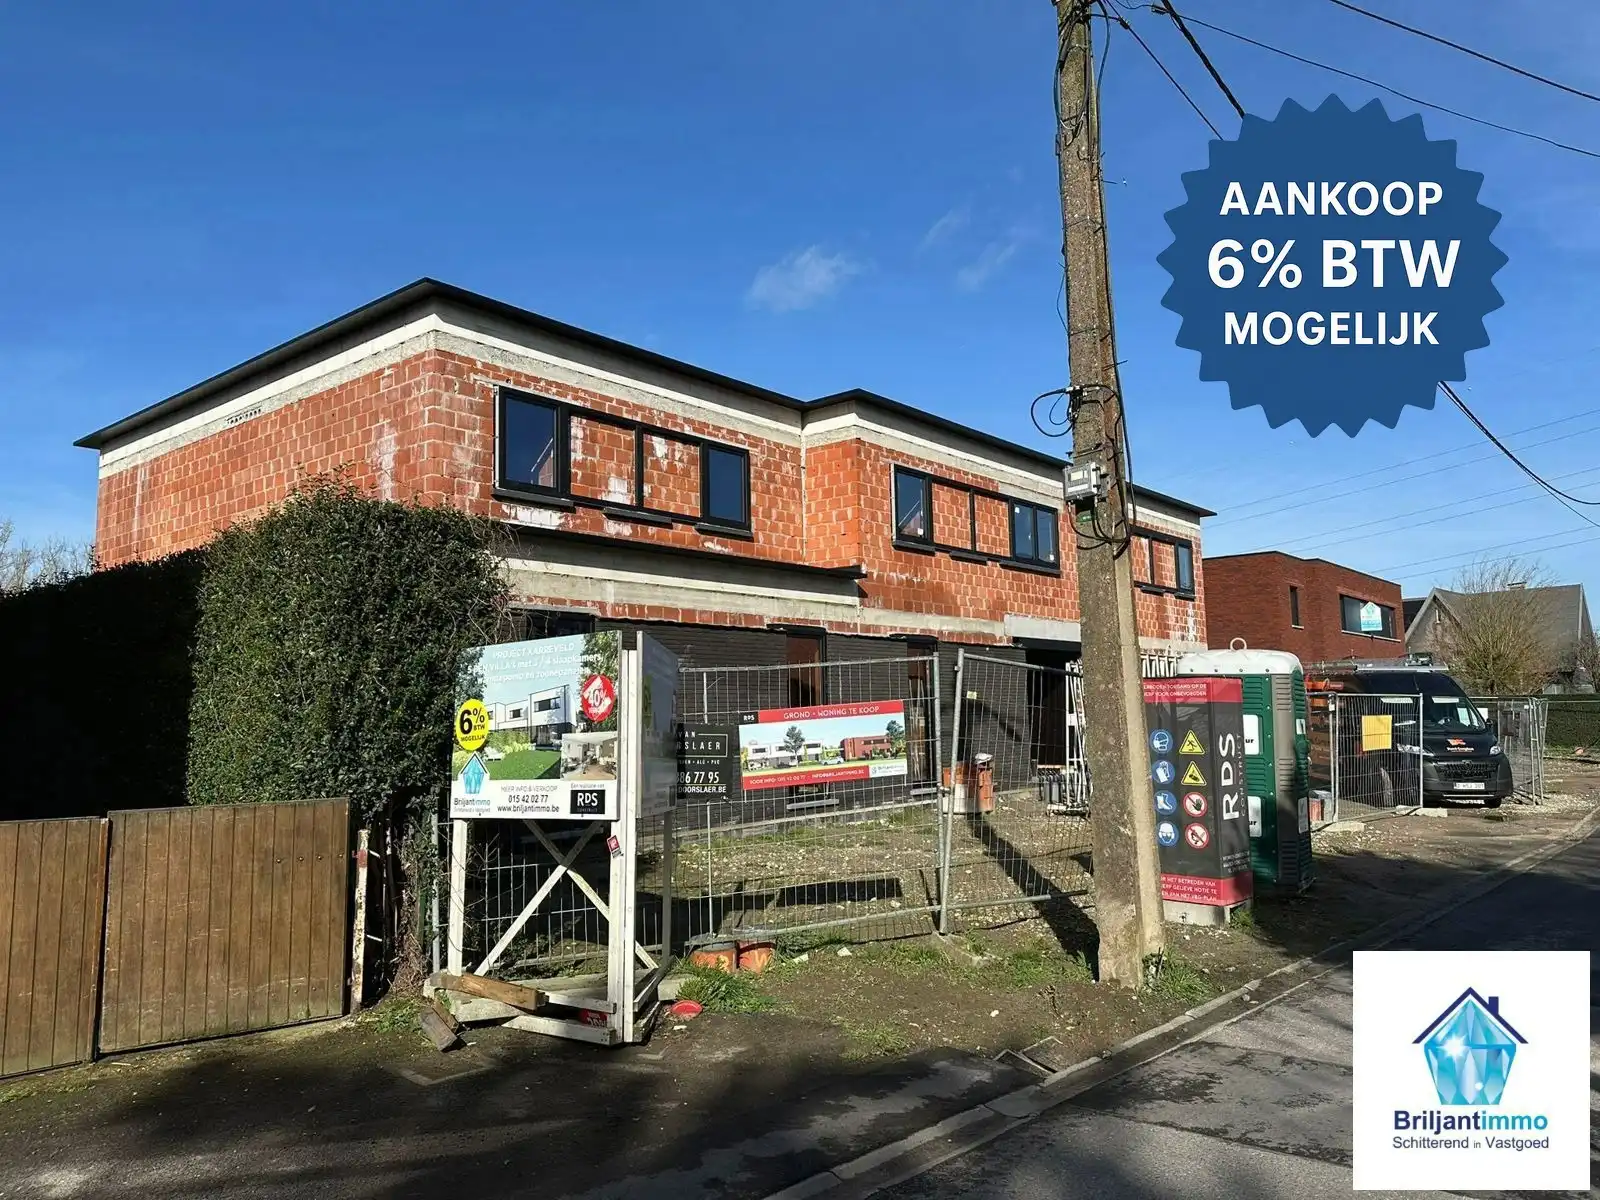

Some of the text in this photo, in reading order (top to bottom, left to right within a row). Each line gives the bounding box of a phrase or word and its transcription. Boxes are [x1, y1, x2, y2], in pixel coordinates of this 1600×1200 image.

[784, 711, 810, 719] GROND
[818, 708, 847, 717] WONING
[859, 706, 880, 714] KOOP
[459, 708, 485, 735] 6%
[694, 771, 706, 784] 77
[707, 771, 720, 784] 95
[1219, 733, 1240, 820] RDS
[1236, 734, 1247, 817] CONSTRUCT
[508, 794, 549, 803] 015 42 02 77
[577, 792, 598, 807] RDS
